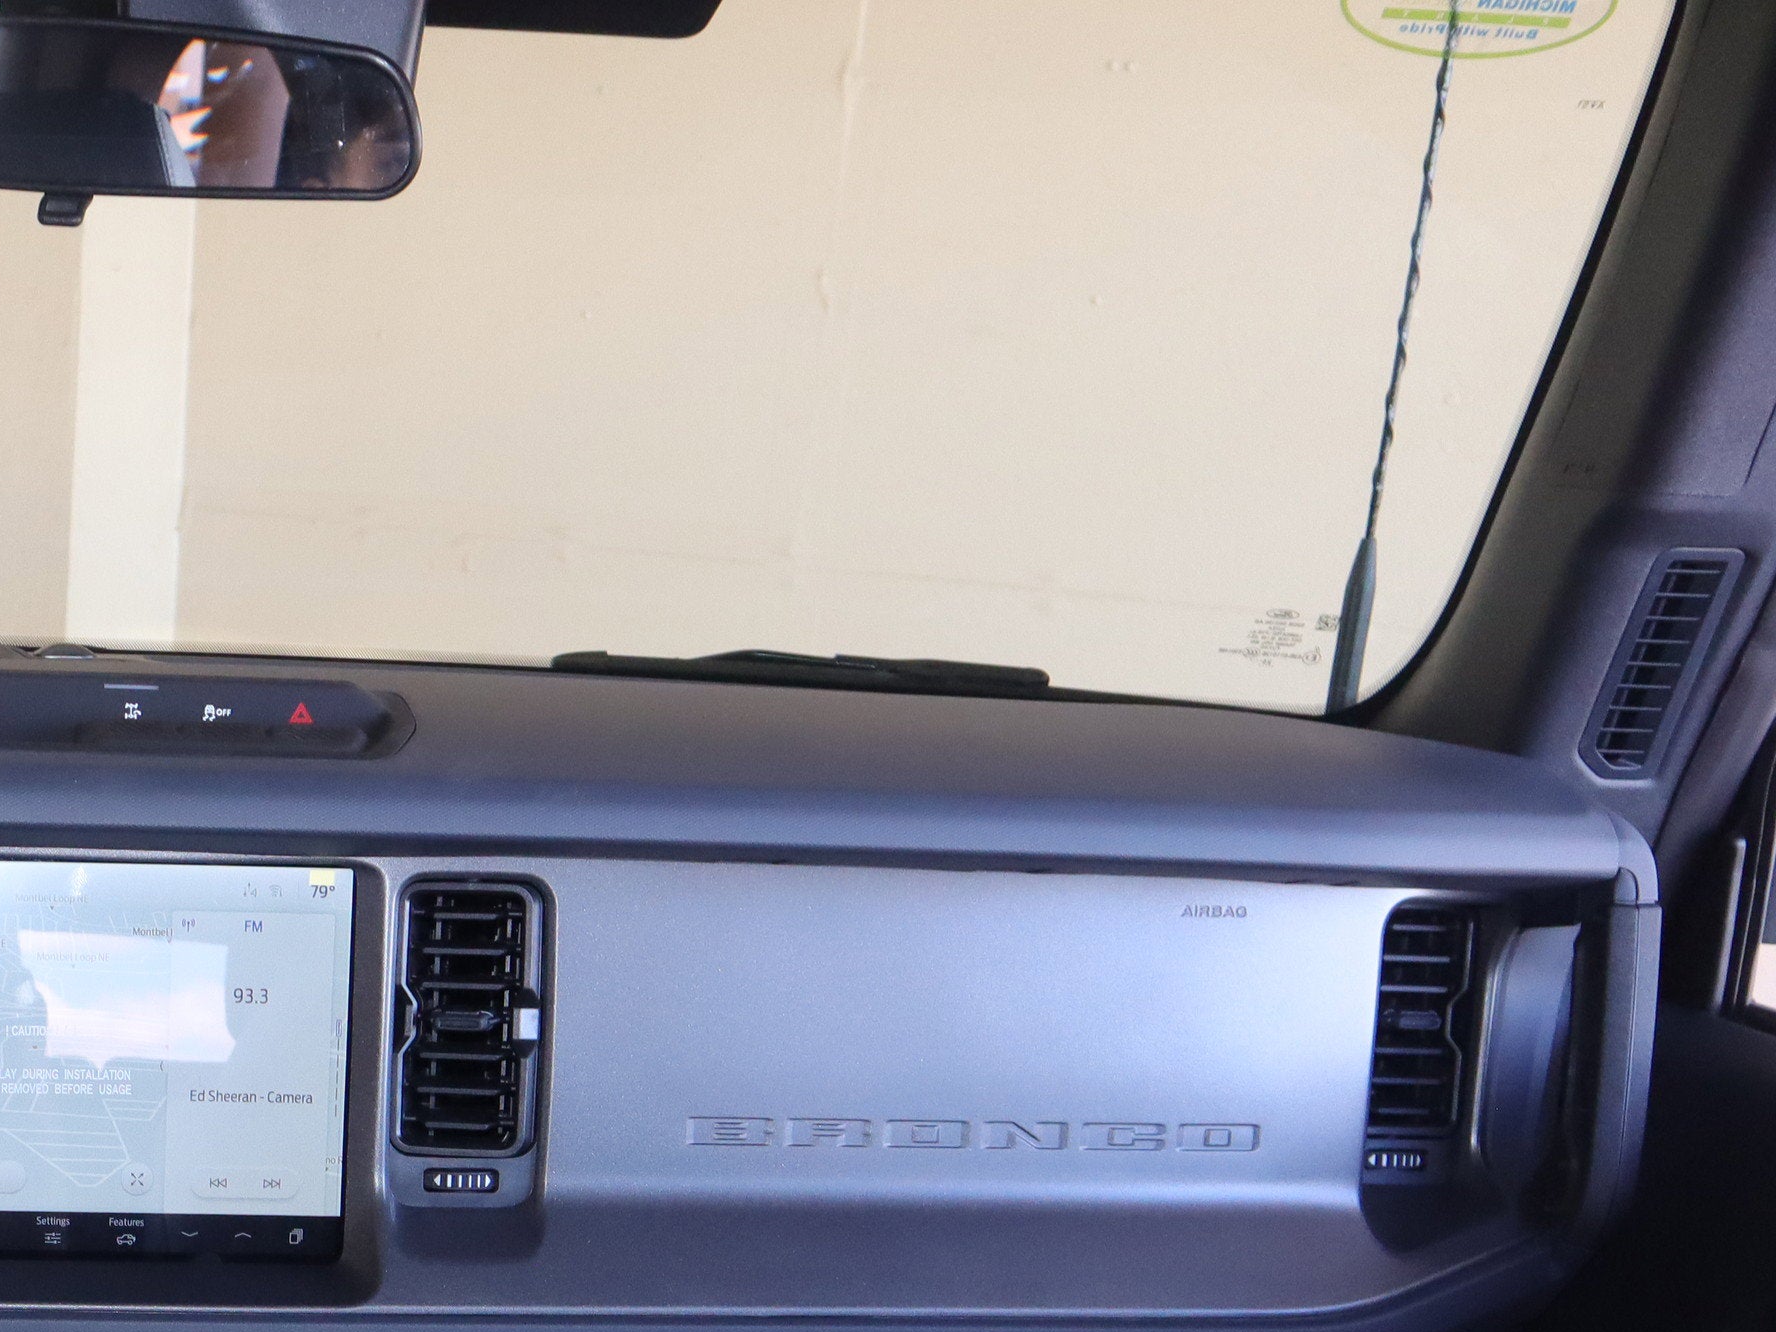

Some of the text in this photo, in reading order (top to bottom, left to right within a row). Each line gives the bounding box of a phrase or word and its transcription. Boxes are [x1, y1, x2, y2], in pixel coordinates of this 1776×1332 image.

[216, 708, 231, 716] OFF
[310, 884, 336, 899] 79°
[244, 920, 263, 932] FM
[232, 987, 269, 1004] 93.3
[11, 1025, 51, 1036] CAUTIO
[22, 1068, 59, 1080] DURING
[64, 1068, 131, 1081] INSTALLATION
[1, 1083, 49, 1094] REMOVED
[54, 1083, 93, 1095] BEFORE
[99, 1084, 132, 1095] USAGE
[189, 1089, 206, 1102] Ed
[208, 1090, 257, 1103] Sheeran
[267, 1091, 313, 1104] Camera
[686, 1116, 1261, 1152] BRONCO
[36, 1215, 70, 1228] Settings
[108, 1217, 144, 1227] Features
